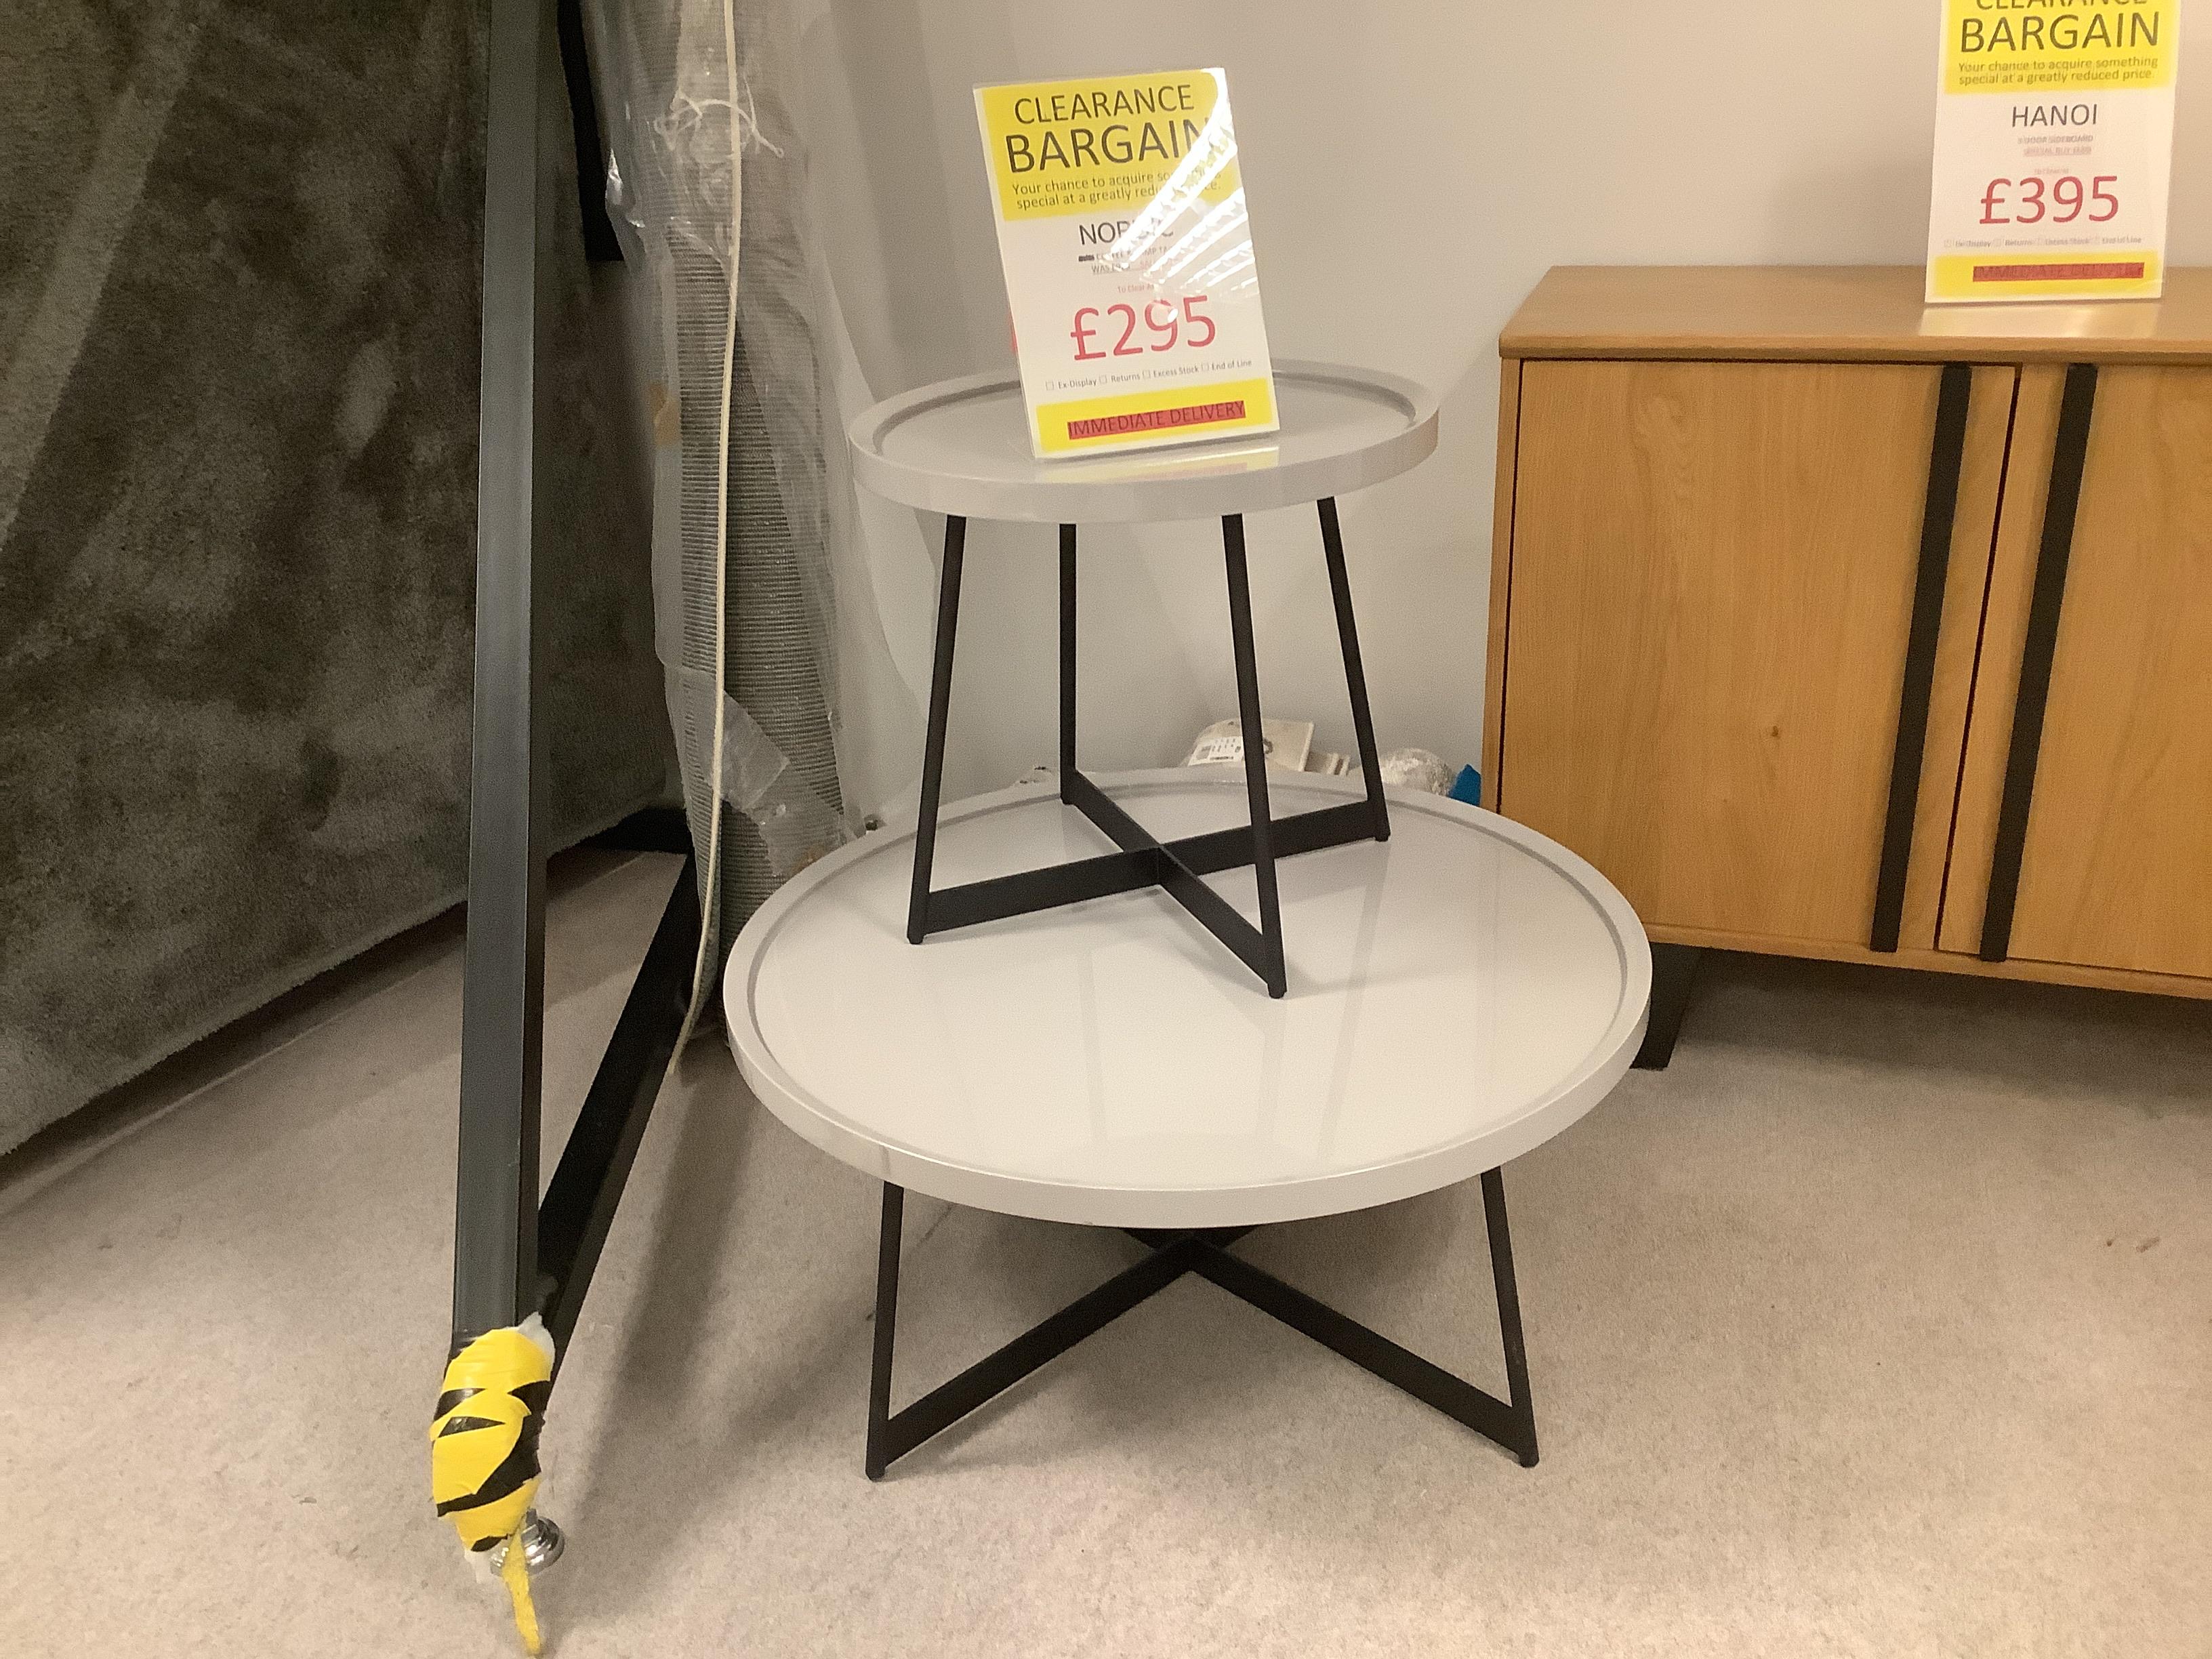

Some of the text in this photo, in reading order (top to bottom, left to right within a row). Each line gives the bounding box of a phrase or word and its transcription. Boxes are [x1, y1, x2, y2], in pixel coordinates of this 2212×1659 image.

[1961, 12, 2159, 52] BARGAIN
[1959, 56, 2158, 73] Your chance to acquire something
[1959, 73, 1999, 86] special
[2002, 73, 2015, 83] at
[2018, 75, 2024, 83] a
[2027, 70, 2067, 85] greatly
[2071, 69, 2119, 81] reduced
[1015, 85, 1194, 124] CLEARANCE
[2011, 104, 2097, 127] HANOI
[1012, 182, 1042, 196] Your
[1045, 177, 1089, 192] chance
[1092, 176, 1105, 188] to
[1109, 171, 1154, 188] acquire
[1017, 192, 1059, 211] special
[1063, 194, 1076, 205] at
[1079, 196, 1086, 204] a
[1090, 186, 1132, 204] greatly
[1980, 176, 2119, 224] £395
[1070, 295, 1216, 361] £295
[1058, 359, 1252, 391] Ex-Display Returns Excess Stock End of Line
[1067, 401, 1245, 436] IMMEDIATE DELIVERY
